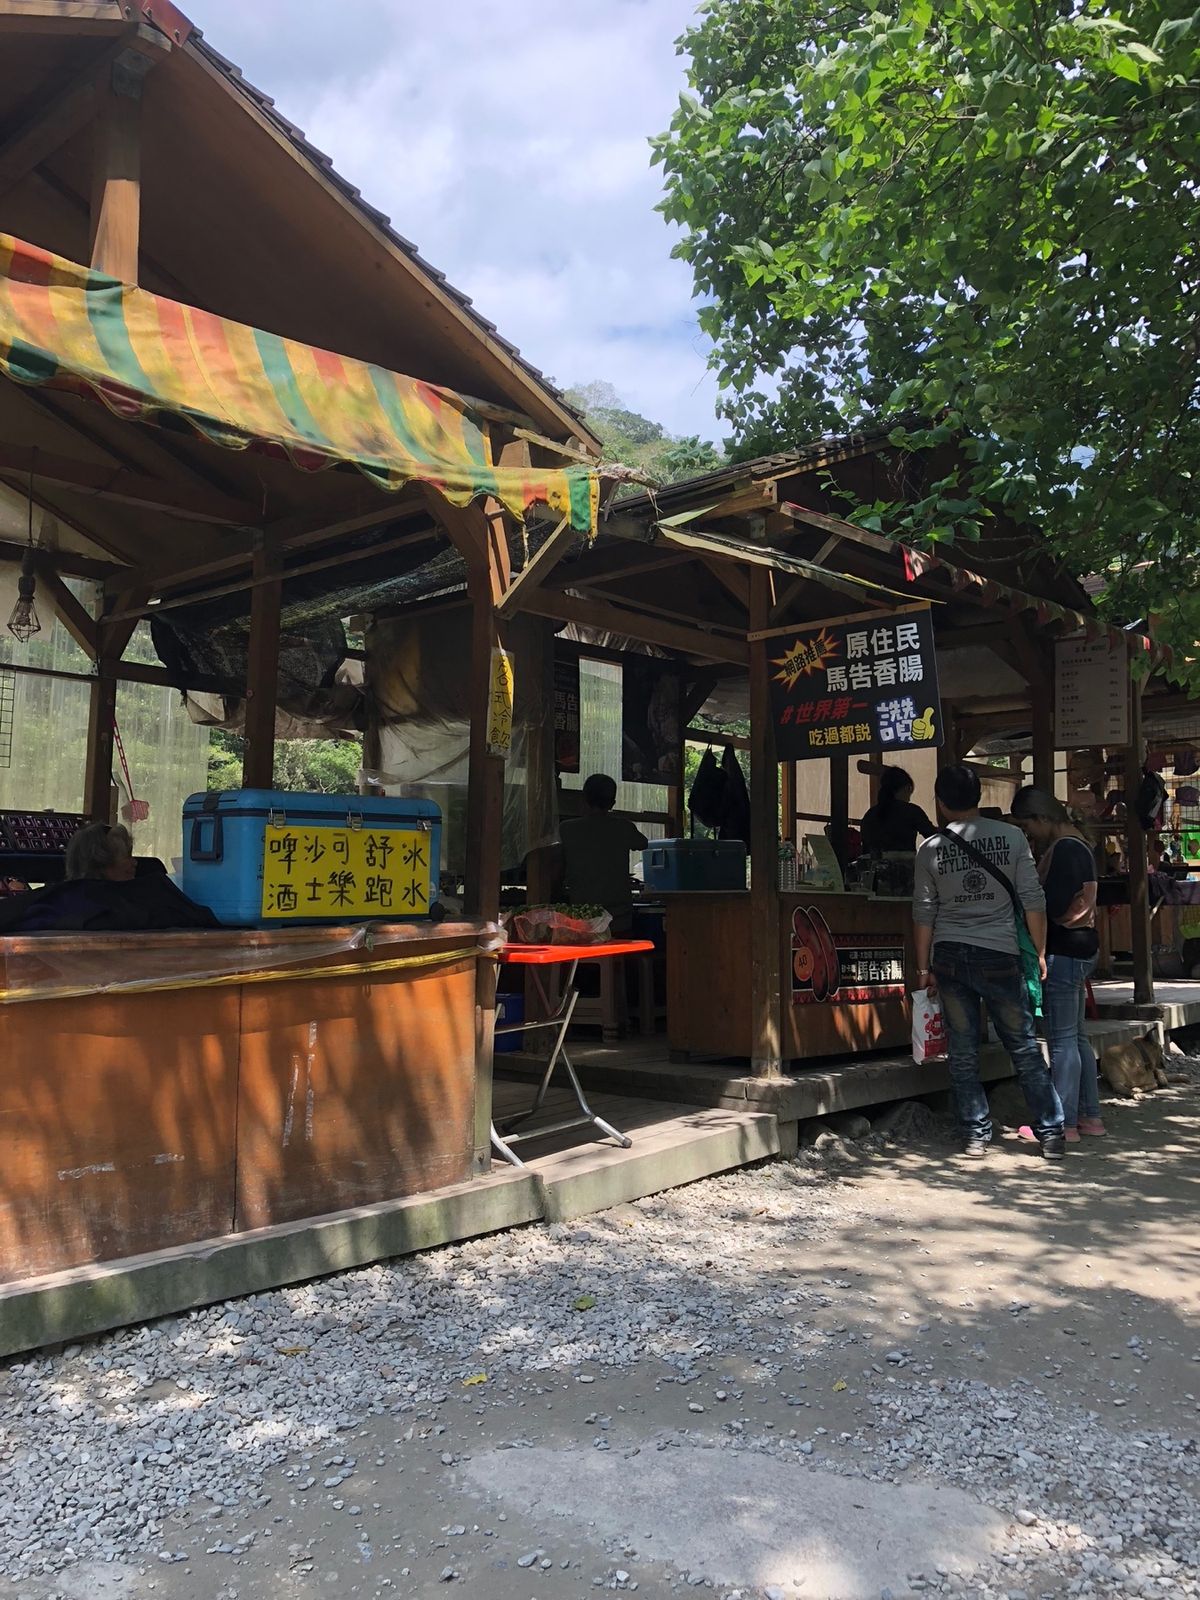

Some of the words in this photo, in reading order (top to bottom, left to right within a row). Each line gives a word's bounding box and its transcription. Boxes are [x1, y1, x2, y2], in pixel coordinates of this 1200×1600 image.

[826, 654, 924, 693] 馬告香腸
[846, 622, 920, 660] 原住民
[780, 697, 868, 725] #世界第一
[267, 832, 298, 912] 啤酒
[328, 832, 356, 907] 可樂
[363, 834, 395, 907] 舒跑
[402, 837, 427, 907] 冰水
